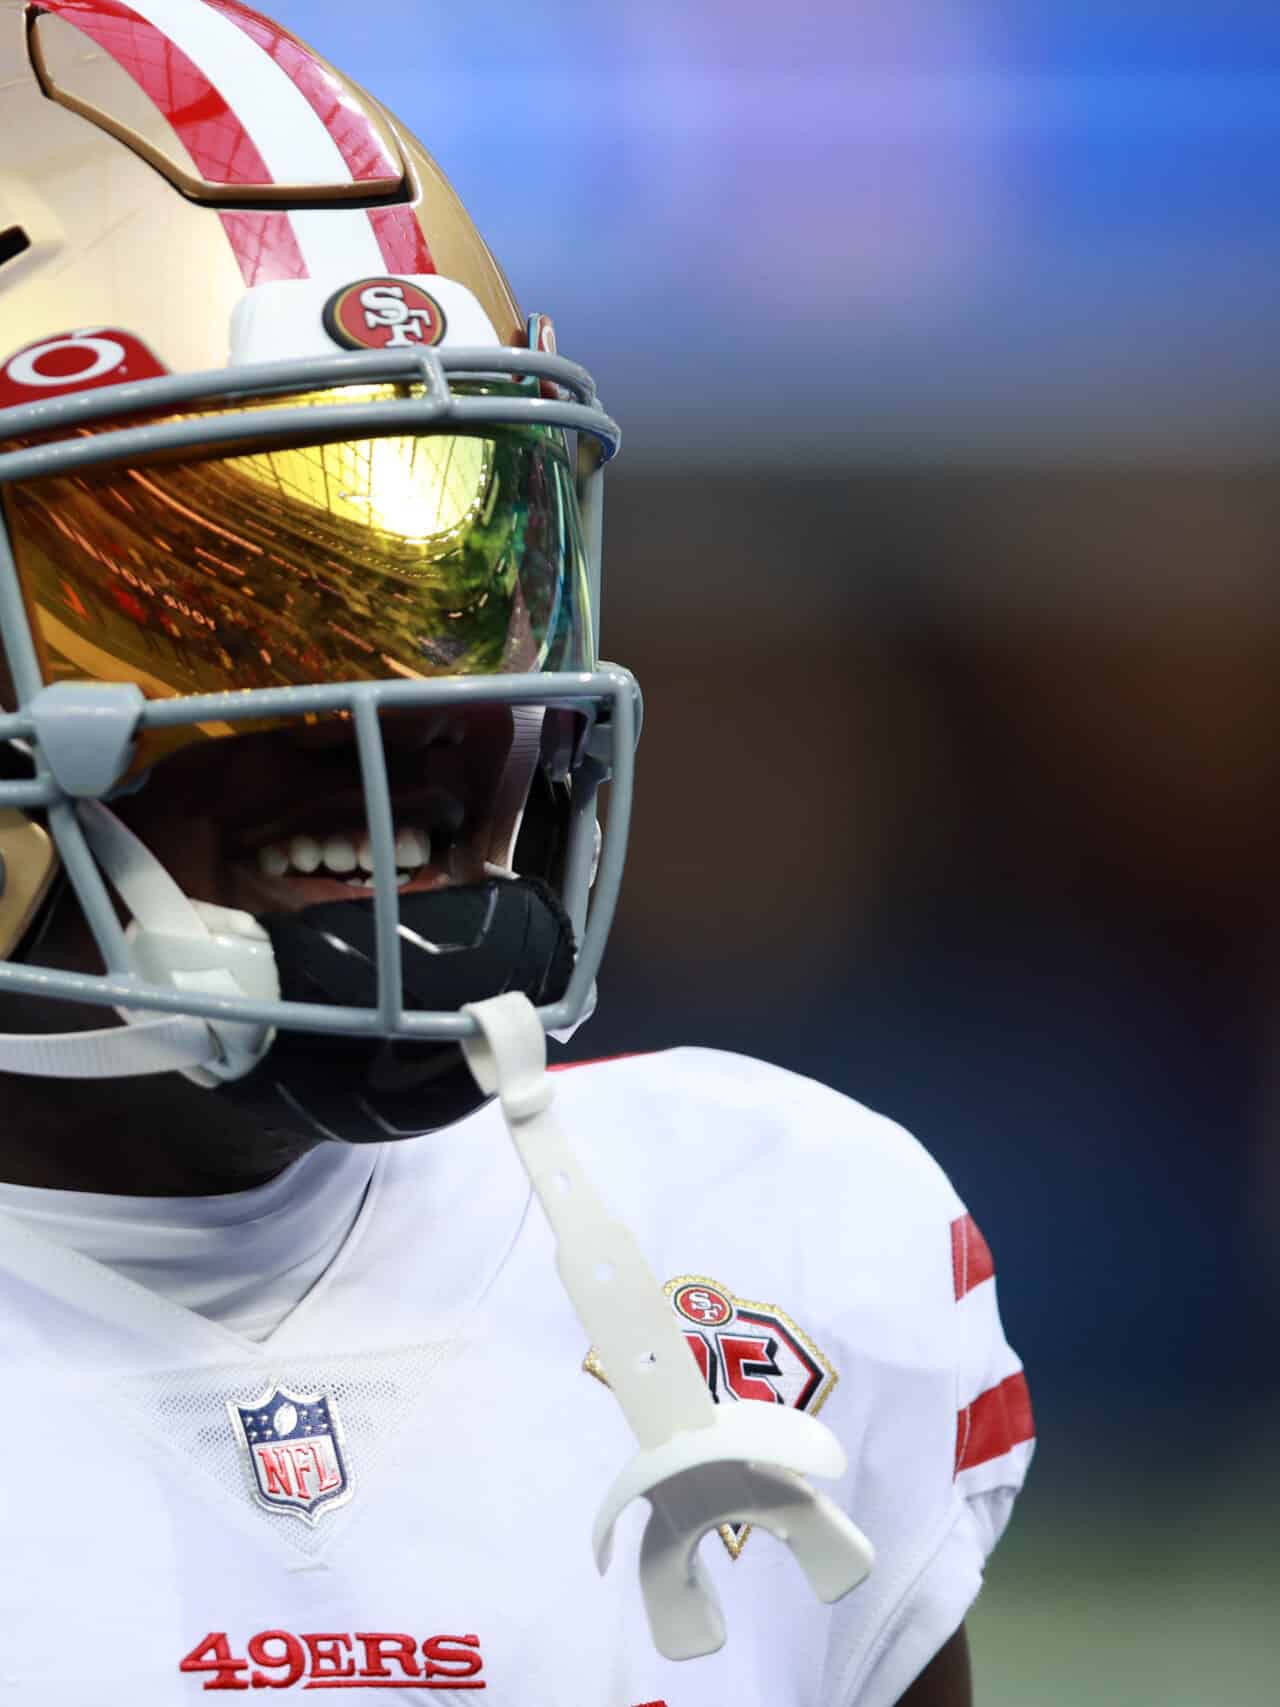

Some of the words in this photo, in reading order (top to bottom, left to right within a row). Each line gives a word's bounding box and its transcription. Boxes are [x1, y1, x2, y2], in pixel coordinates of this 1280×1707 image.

[359, 286, 432, 347] SF
[258, 1441, 342, 1500] NFL
[179, 1628, 486, 1690] 49ERS
